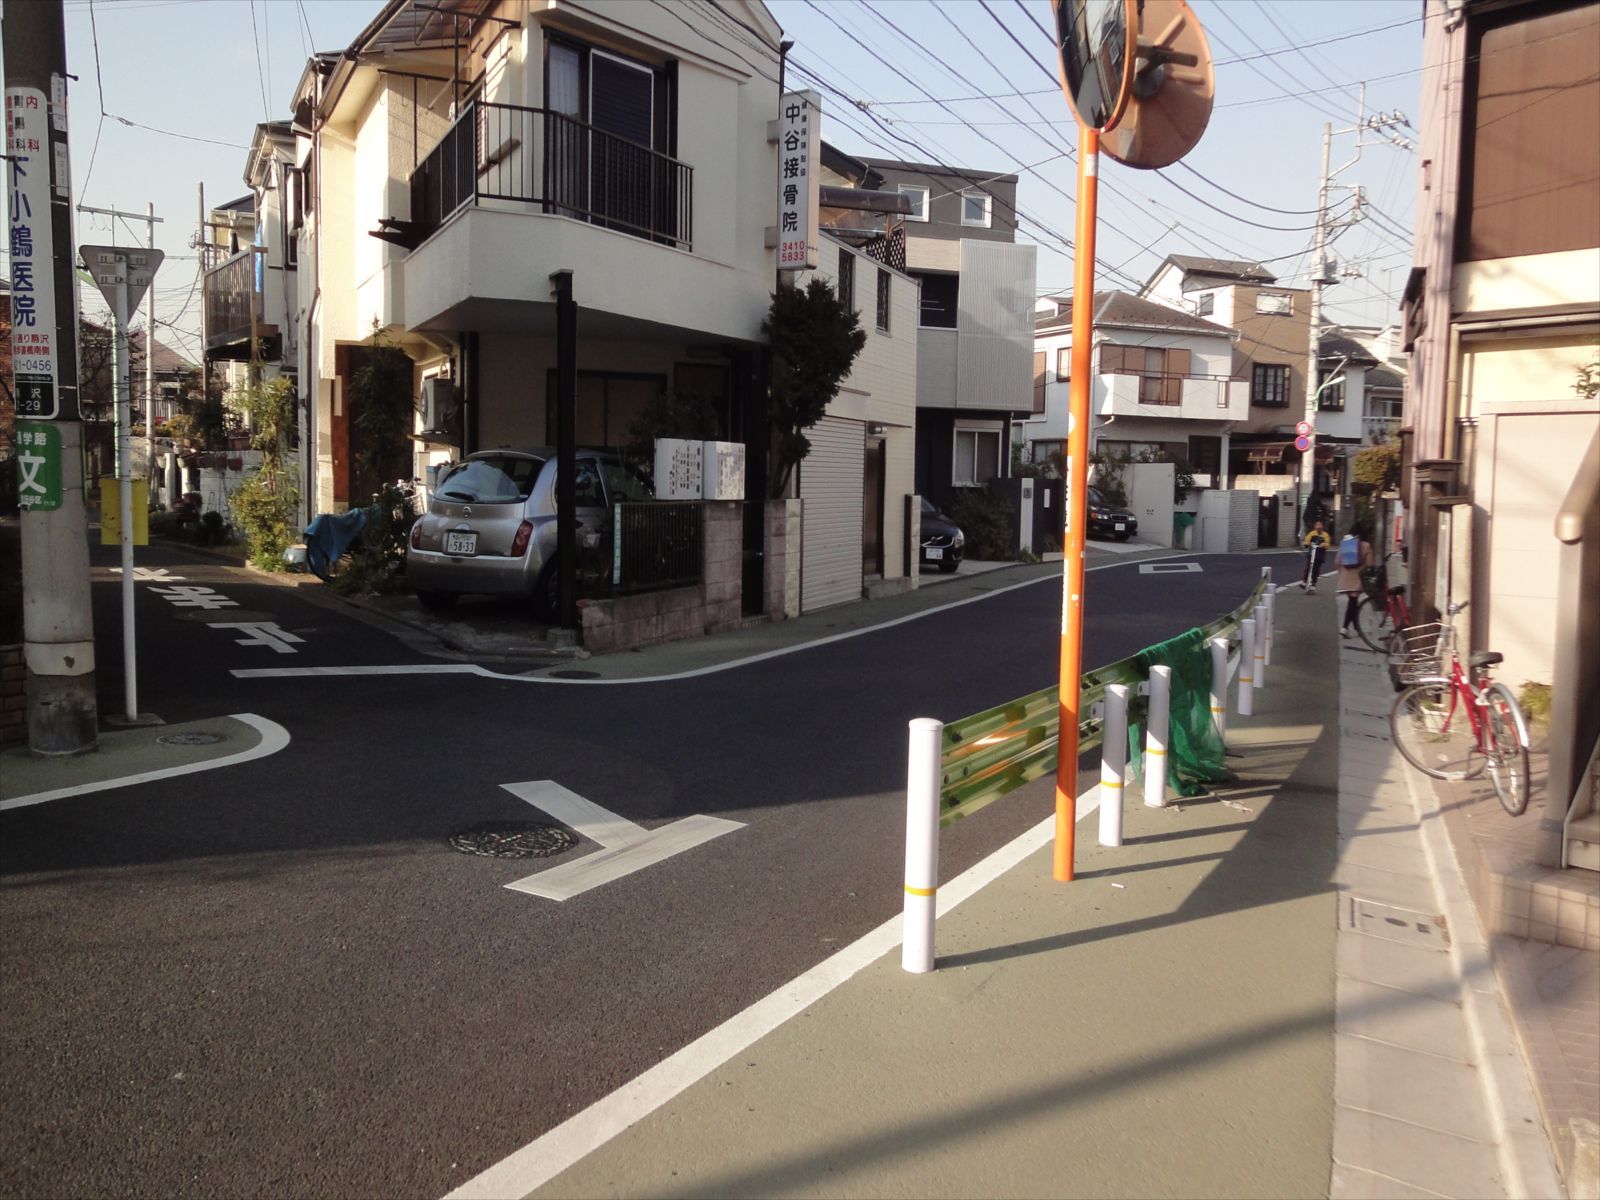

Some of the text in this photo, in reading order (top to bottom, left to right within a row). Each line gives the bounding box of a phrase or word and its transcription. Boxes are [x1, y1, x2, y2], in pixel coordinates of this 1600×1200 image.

[26, 95, 40, 152] 内科
[782, 103, 800, 232] 中谷接骨院
[782, 241, 805, 252] 3410
[782, 251, 805, 262] 5833
[18, 450, 47, 494] 文
